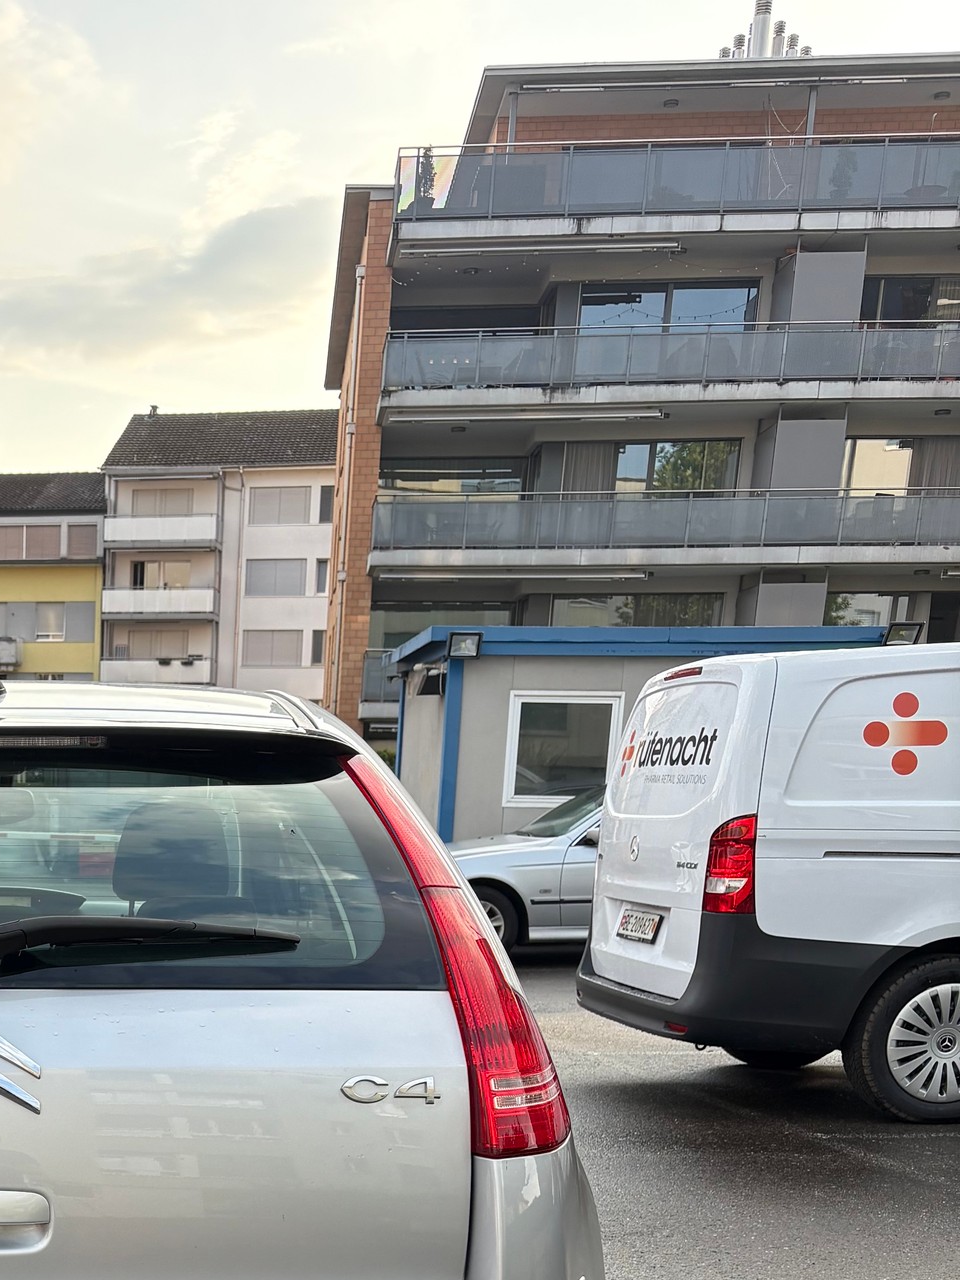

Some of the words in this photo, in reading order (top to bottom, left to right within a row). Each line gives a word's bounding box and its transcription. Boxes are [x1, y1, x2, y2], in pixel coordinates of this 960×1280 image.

[633, 726, 718, 768] rüfenacht
[676, 774, 708, 785] SOLUTIONS
[340, 1075, 441, 1104] C4
